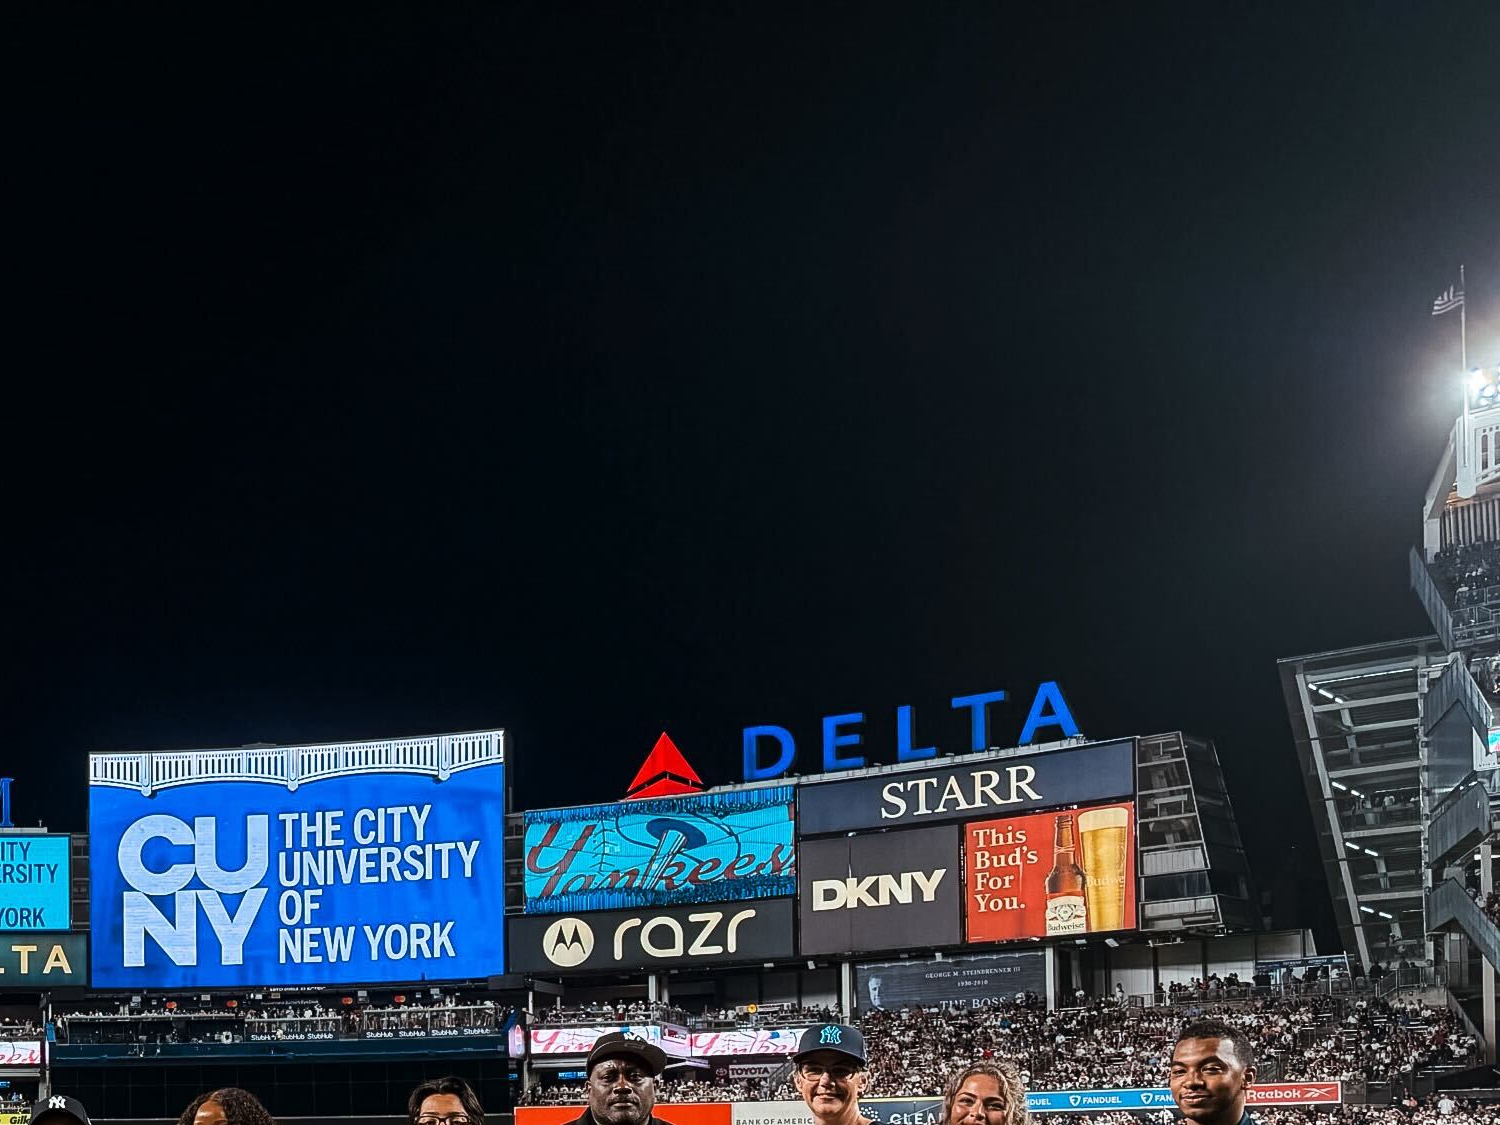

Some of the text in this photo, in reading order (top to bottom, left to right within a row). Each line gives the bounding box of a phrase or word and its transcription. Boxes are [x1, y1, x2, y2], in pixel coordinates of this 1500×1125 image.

[742, 681, 1083, 780] DELTA
[881, 764, 1043, 820] STARR
[278, 804, 432, 849] THE CITY
[973, 826, 1027, 848] This
[118, 814, 269, 896] CU
[278, 840, 480, 887] UNIVERSITY
[974, 846, 1039, 870] Bud's
[811, 869, 947, 912] DKNY
[975, 872, 1015, 891] For
[278, 888, 323, 926] OF
[975, 894, 1026, 913] You.
[123, 888, 268, 967] NY
[613, 908, 758, 961] razr
[278, 921, 456, 964] NEW YORK
[925, 971, 951, 979] GEORGE
[962, 967, 1012, 977] STEINBRENNER
[972, 997, 1006, 1009] BOSS
[819, 1025, 843, 1045] NY
[730, 1067, 770, 1076] TOYOTA
[49, 1096, 66, 1109] NY
[1083, 1095, 1122, 1105] FANDUEL
[1246, 1088, 1301, 1100] Reebok
[889, 1113, 943, 1125] CLEA
